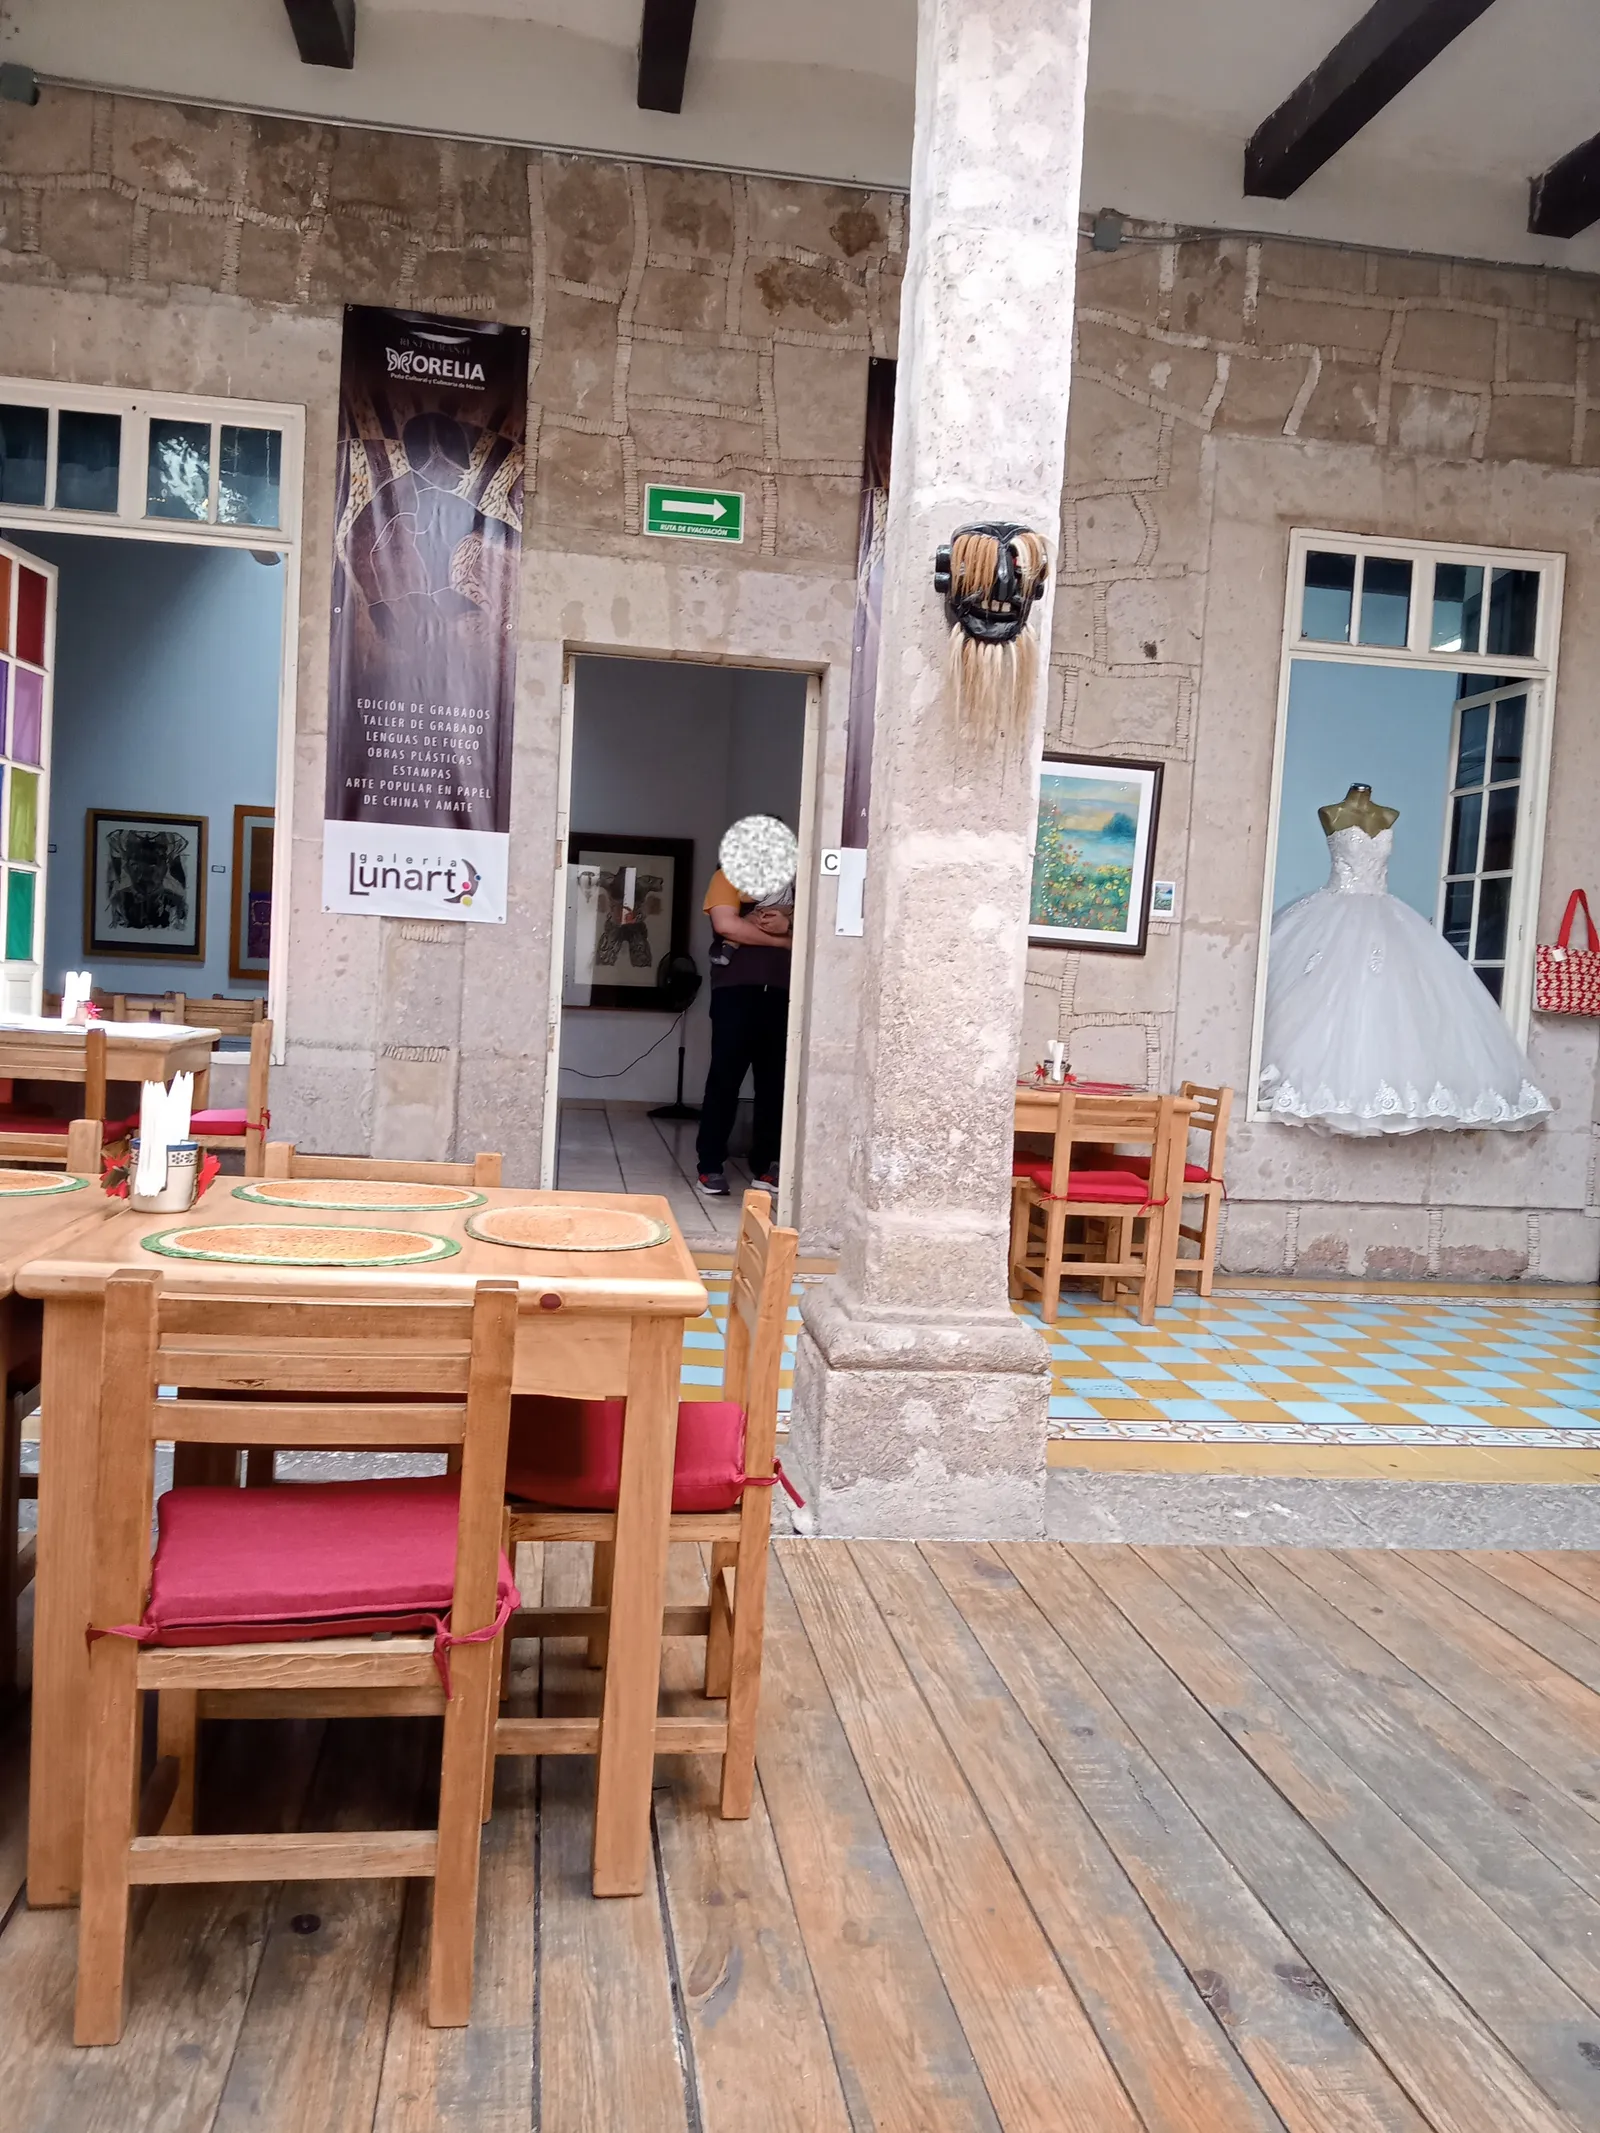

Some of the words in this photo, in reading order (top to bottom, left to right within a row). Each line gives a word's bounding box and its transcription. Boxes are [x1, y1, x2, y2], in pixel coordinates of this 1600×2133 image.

[660, 523, 677, 531] RUTA
[687, 526, 729, 536] EVACUACIÓN
[357, 698, 405, 712] EDICIÓN
[410, 703, 424, 714] DE
[430, 704, 491, 720] GRABADOS
[363, 714, 405, 728] TALLER
[410, 719, 424, 730] DE
[430, 721, 484, 735] GRABADO
[366, 731, 418, 745] LENGUAS
[424, 736, 438, 747] DE
[443, 737, 480, 751] FUEGO
[367, 747, 405, 760] OBRAS
[410, 750, 473, 766] PLÁSTICAS
[393, 765, 452, 780] ESTAMPAS
[345, 778, 374, 790] ARTE
[380, 780, 433, 794] POPULAR
[438, 785, 452, 795] EN
[457, 786, 492, 799] PAPEL
[364, 794, 378, 805] DE
[383, 796, 419, 809] CHINA
[424, 799, 431, 809] Y
[436, 801, 473, 813] AMATE
[824, 854, 838, 871] C
[349, 852, 457, 896] Lunart
